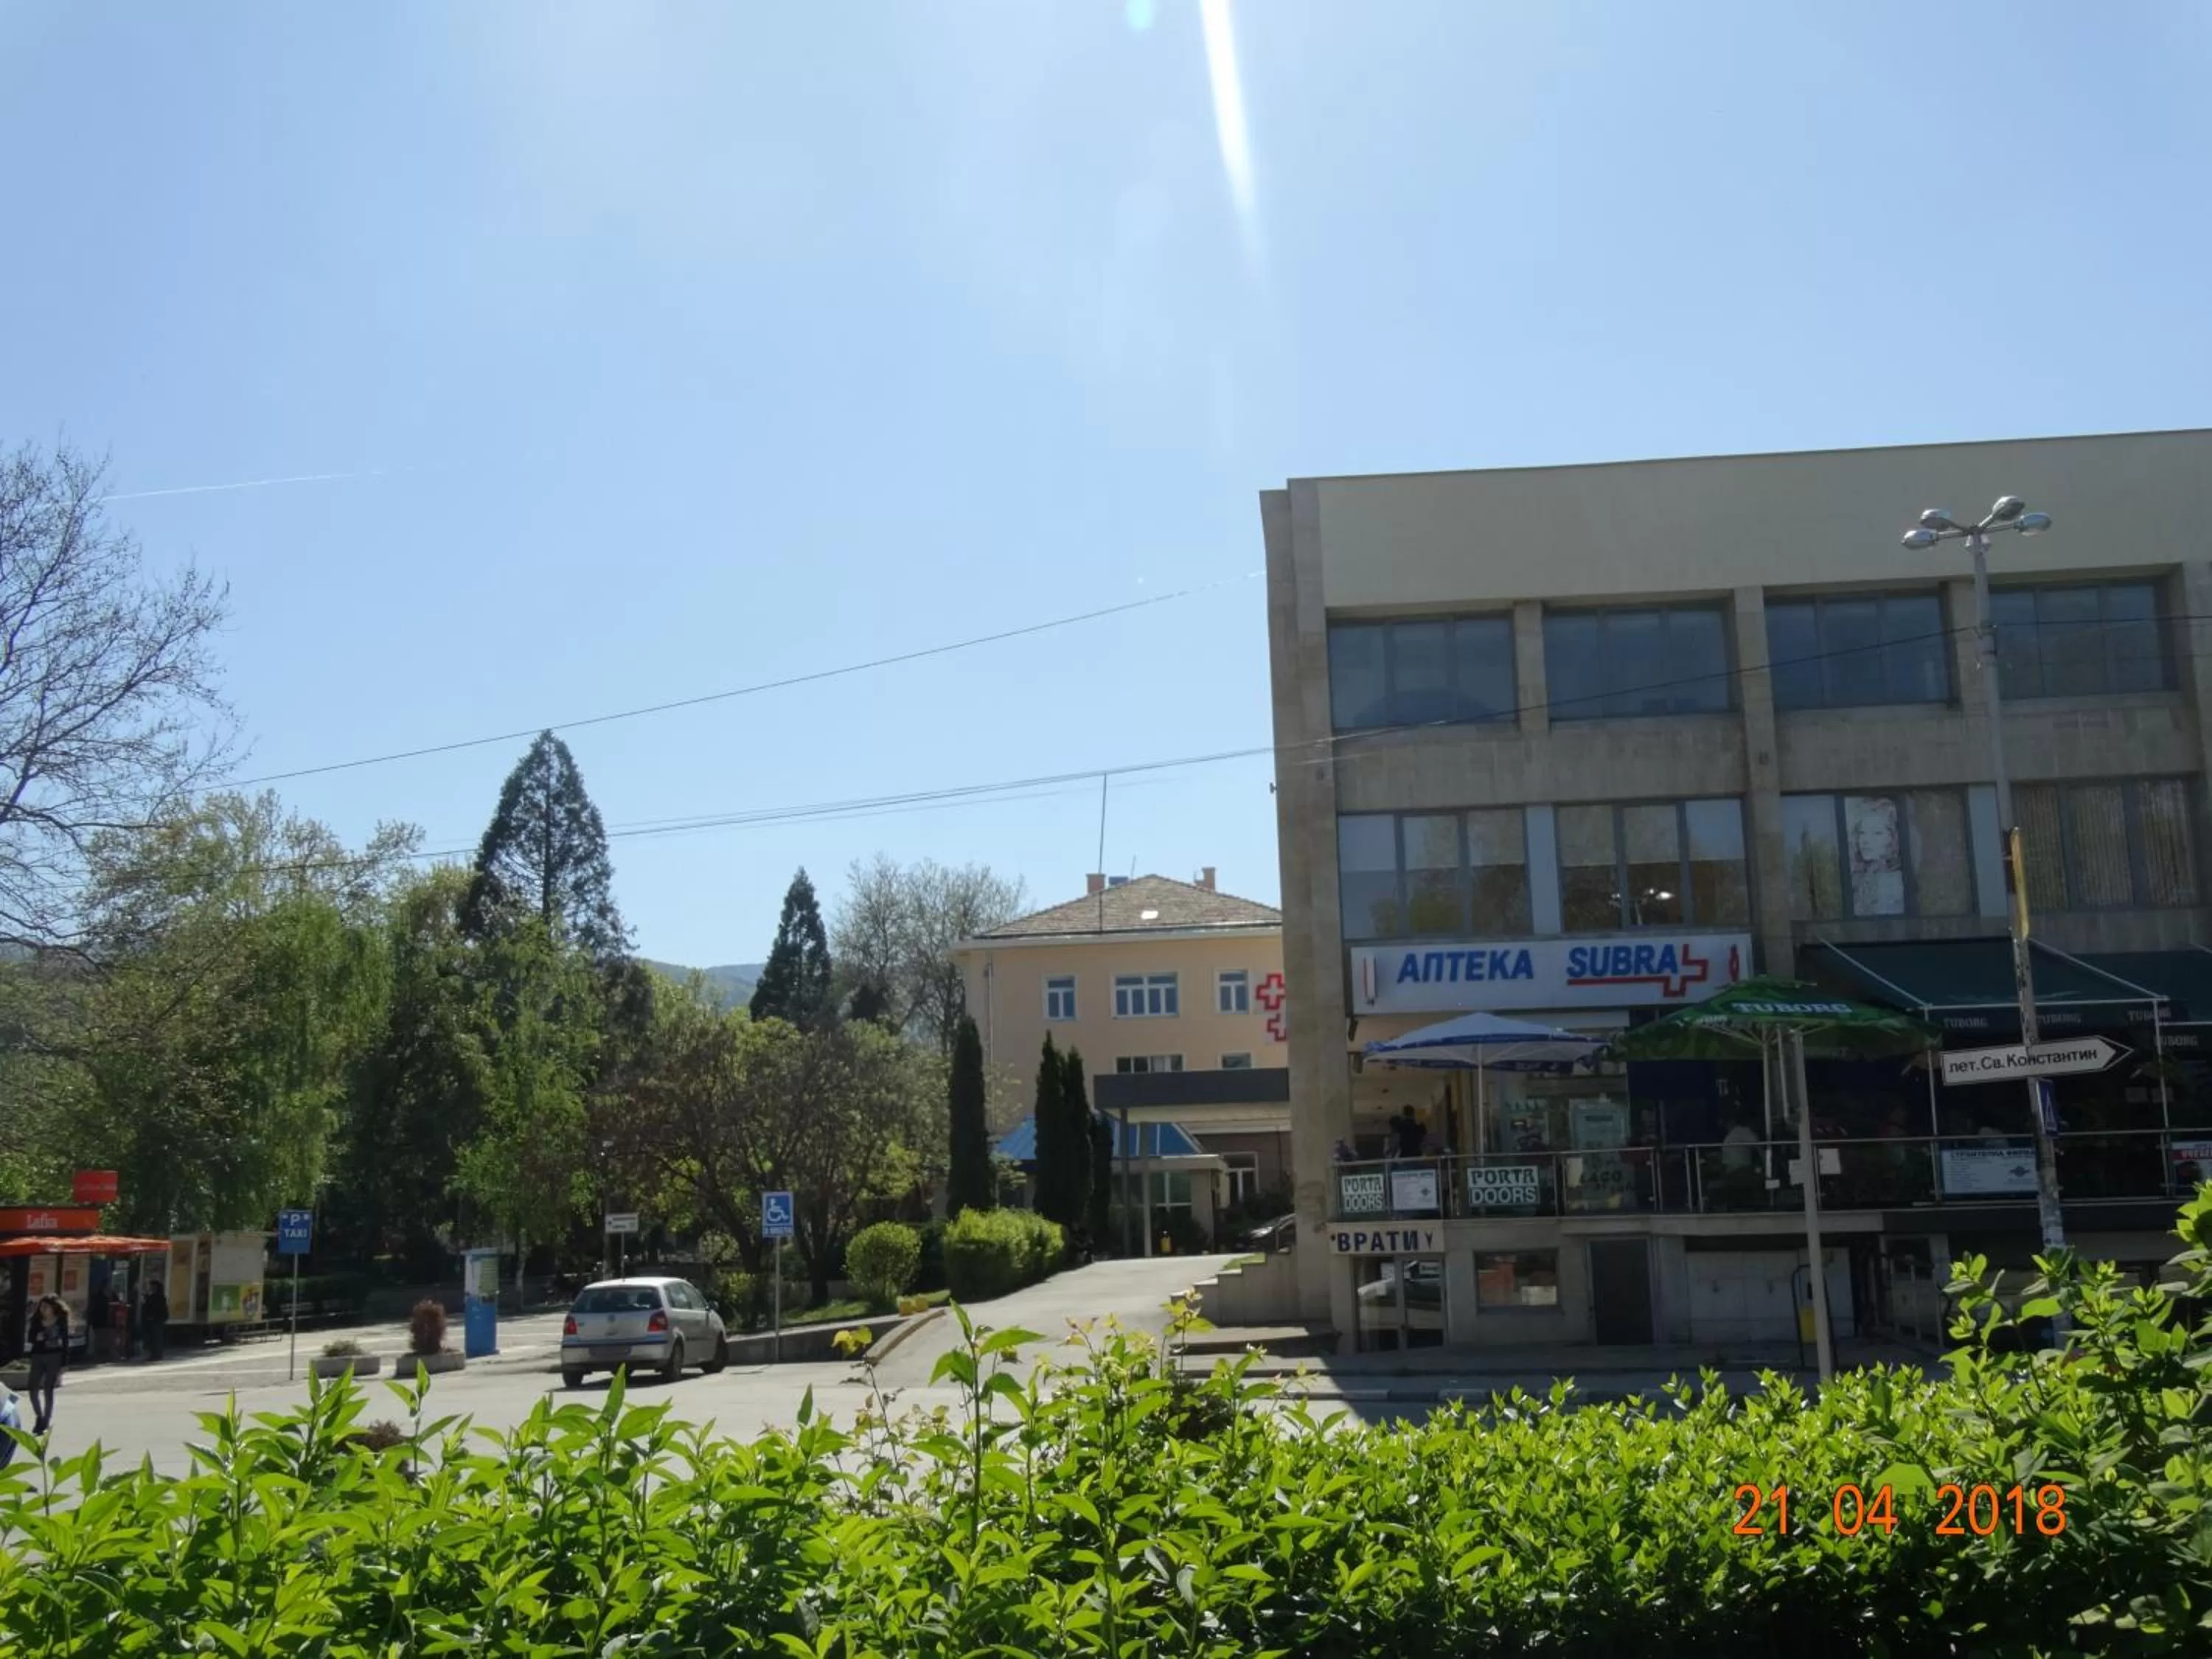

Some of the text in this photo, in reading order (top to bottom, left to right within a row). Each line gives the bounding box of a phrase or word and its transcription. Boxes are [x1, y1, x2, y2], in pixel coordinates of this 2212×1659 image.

[1397, 949, 1534, 984] АПТЕКА
[1565, 943, 1678, 978] SUBRA
[1731, 1002, 1853, 1013] TUBORG
[2006, 1049, 2097, 1067] Константин
[1470, 1168, 1534, 1184] PORTA
[1344, 1178, 1383, 1192] PORTA
[1345, 1194, 1382, 1210] DOORS
[1470, 1187, 1536, 1204] DOORS
[290, 1213, 300, 1226] P
[284, 1228, 307, 1239] TAXI
[1337, 1230, 1418, 1252] ВРАТИ
